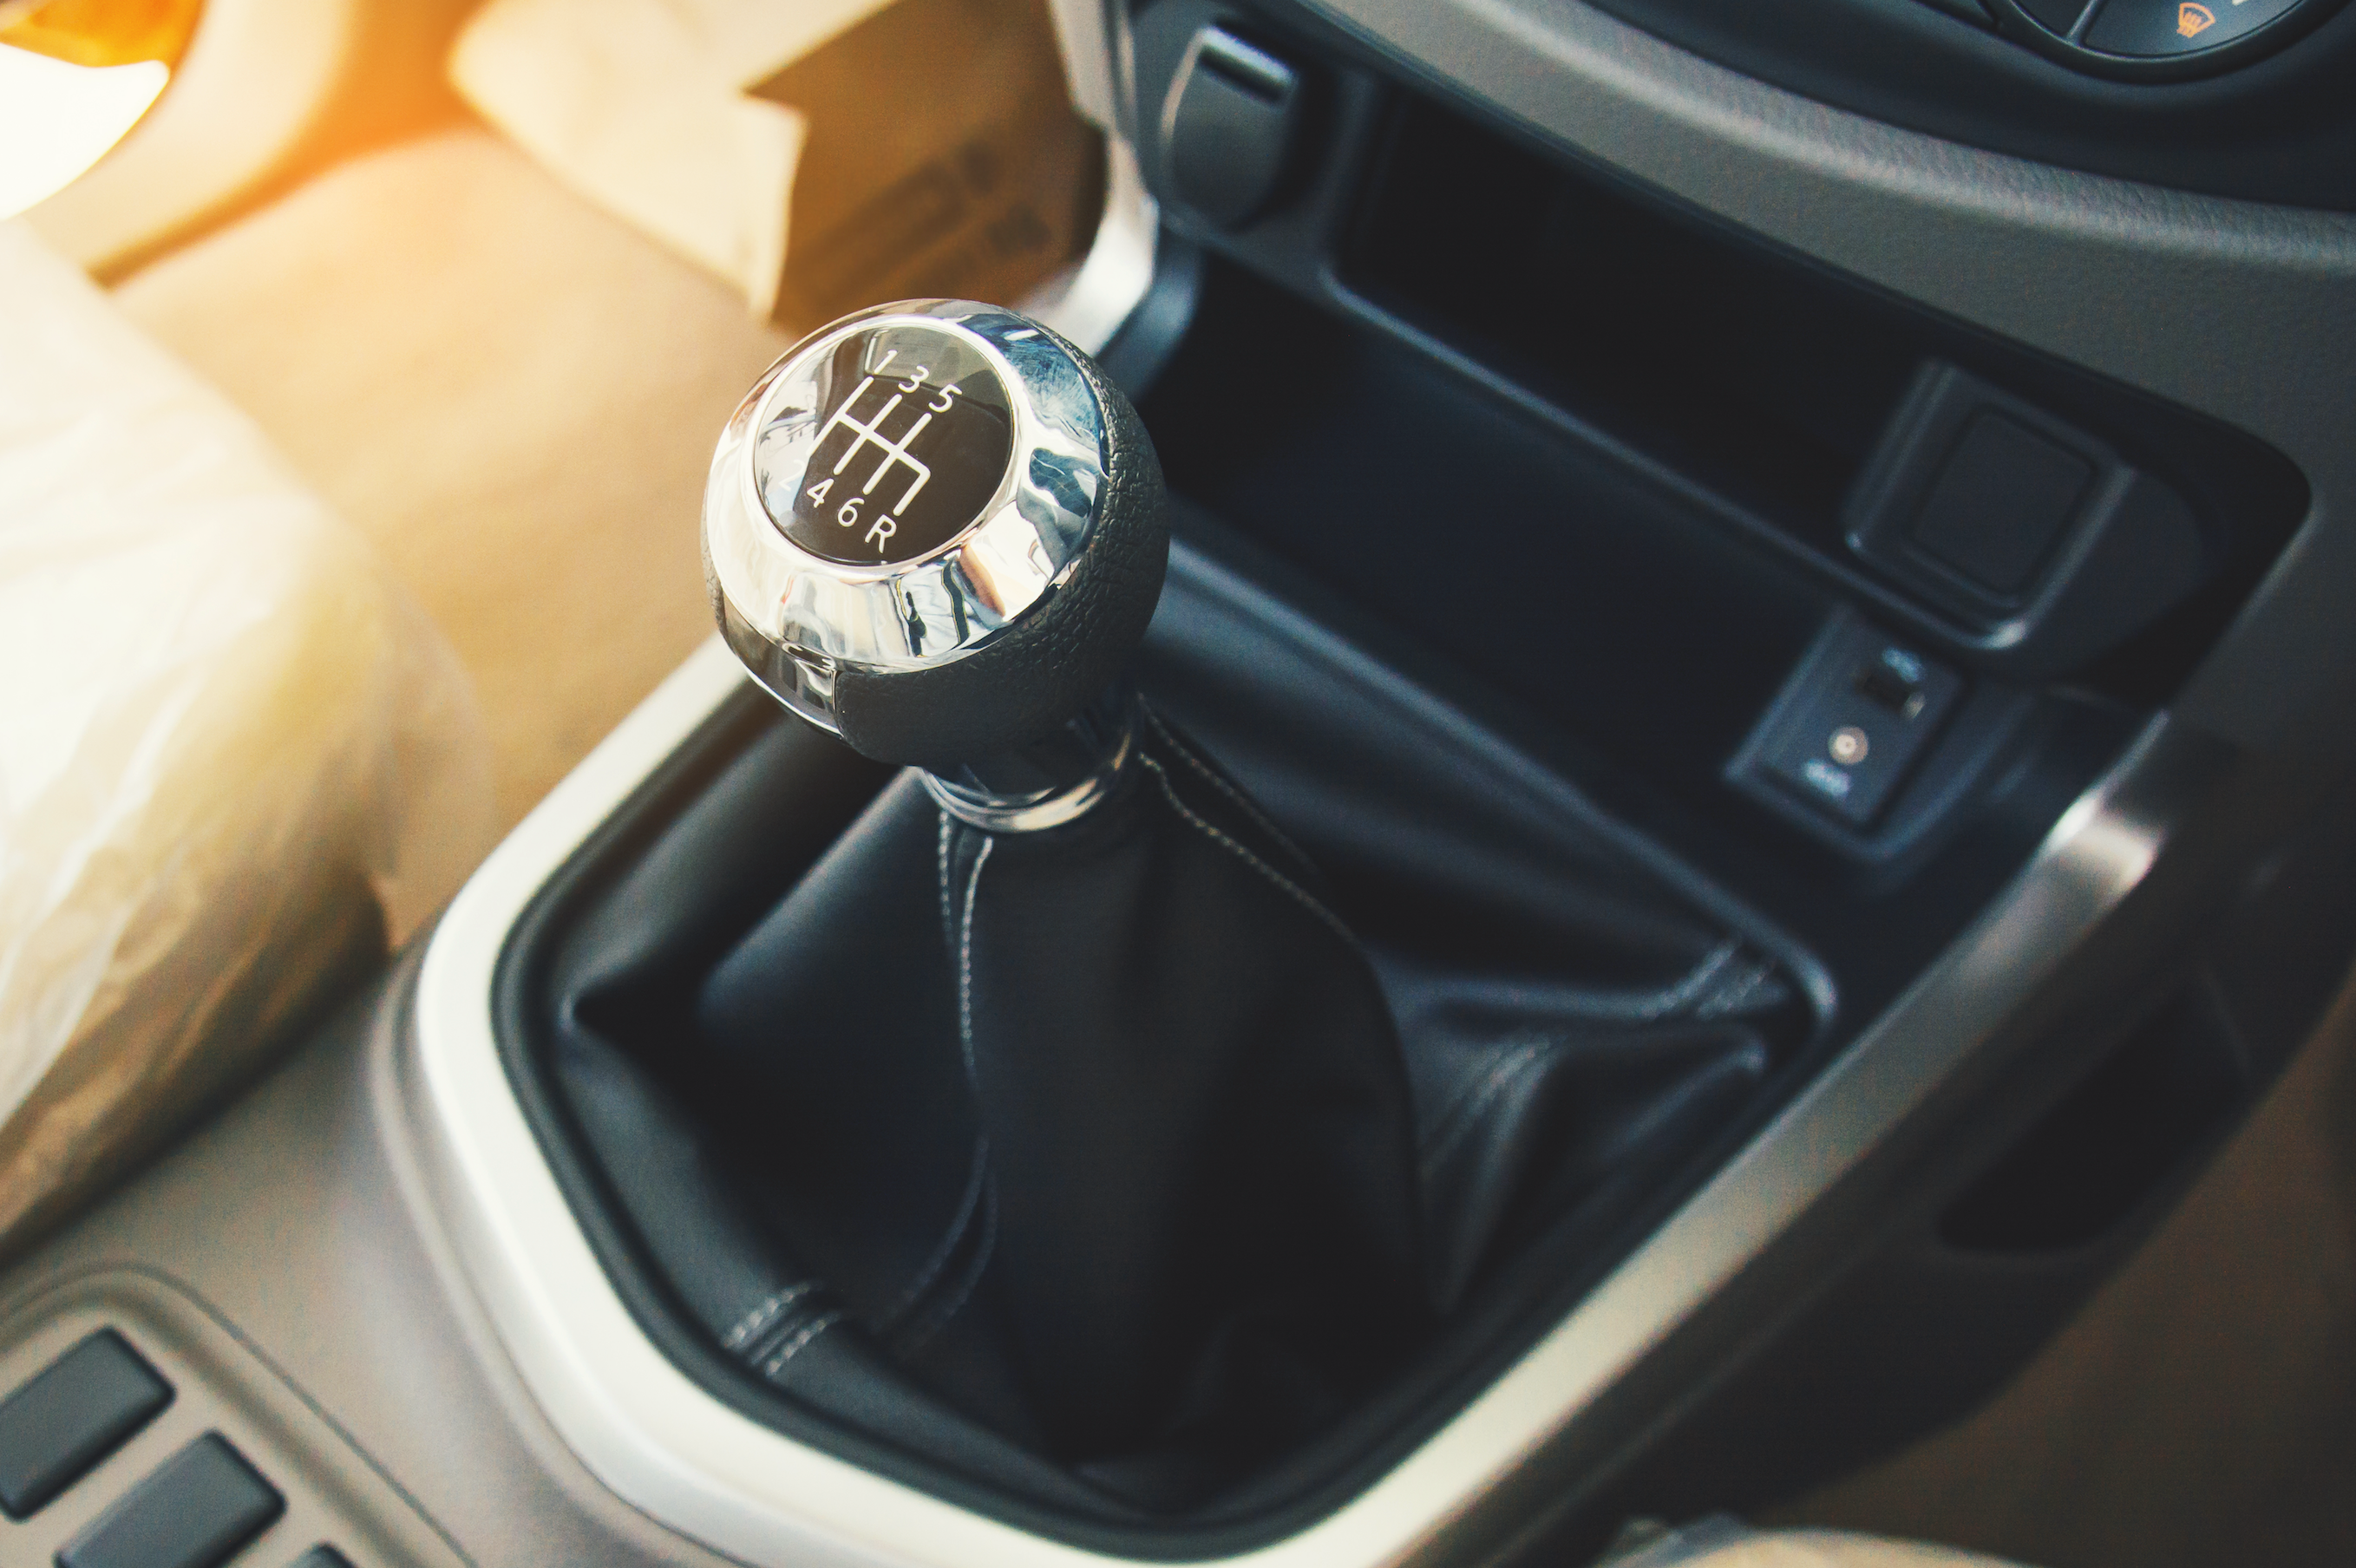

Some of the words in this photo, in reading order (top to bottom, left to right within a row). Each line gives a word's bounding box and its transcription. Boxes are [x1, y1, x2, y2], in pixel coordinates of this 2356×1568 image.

[874, 350, 897, 375] 1
[898, 365, 929, 394] 3
[928, 384, 963, 413] 5
[779, 459, 806, 492] 2
[807, 478, 834, 508] 4
[837, 497, 865, 527] 6
[865, 514, 897, 553] R
